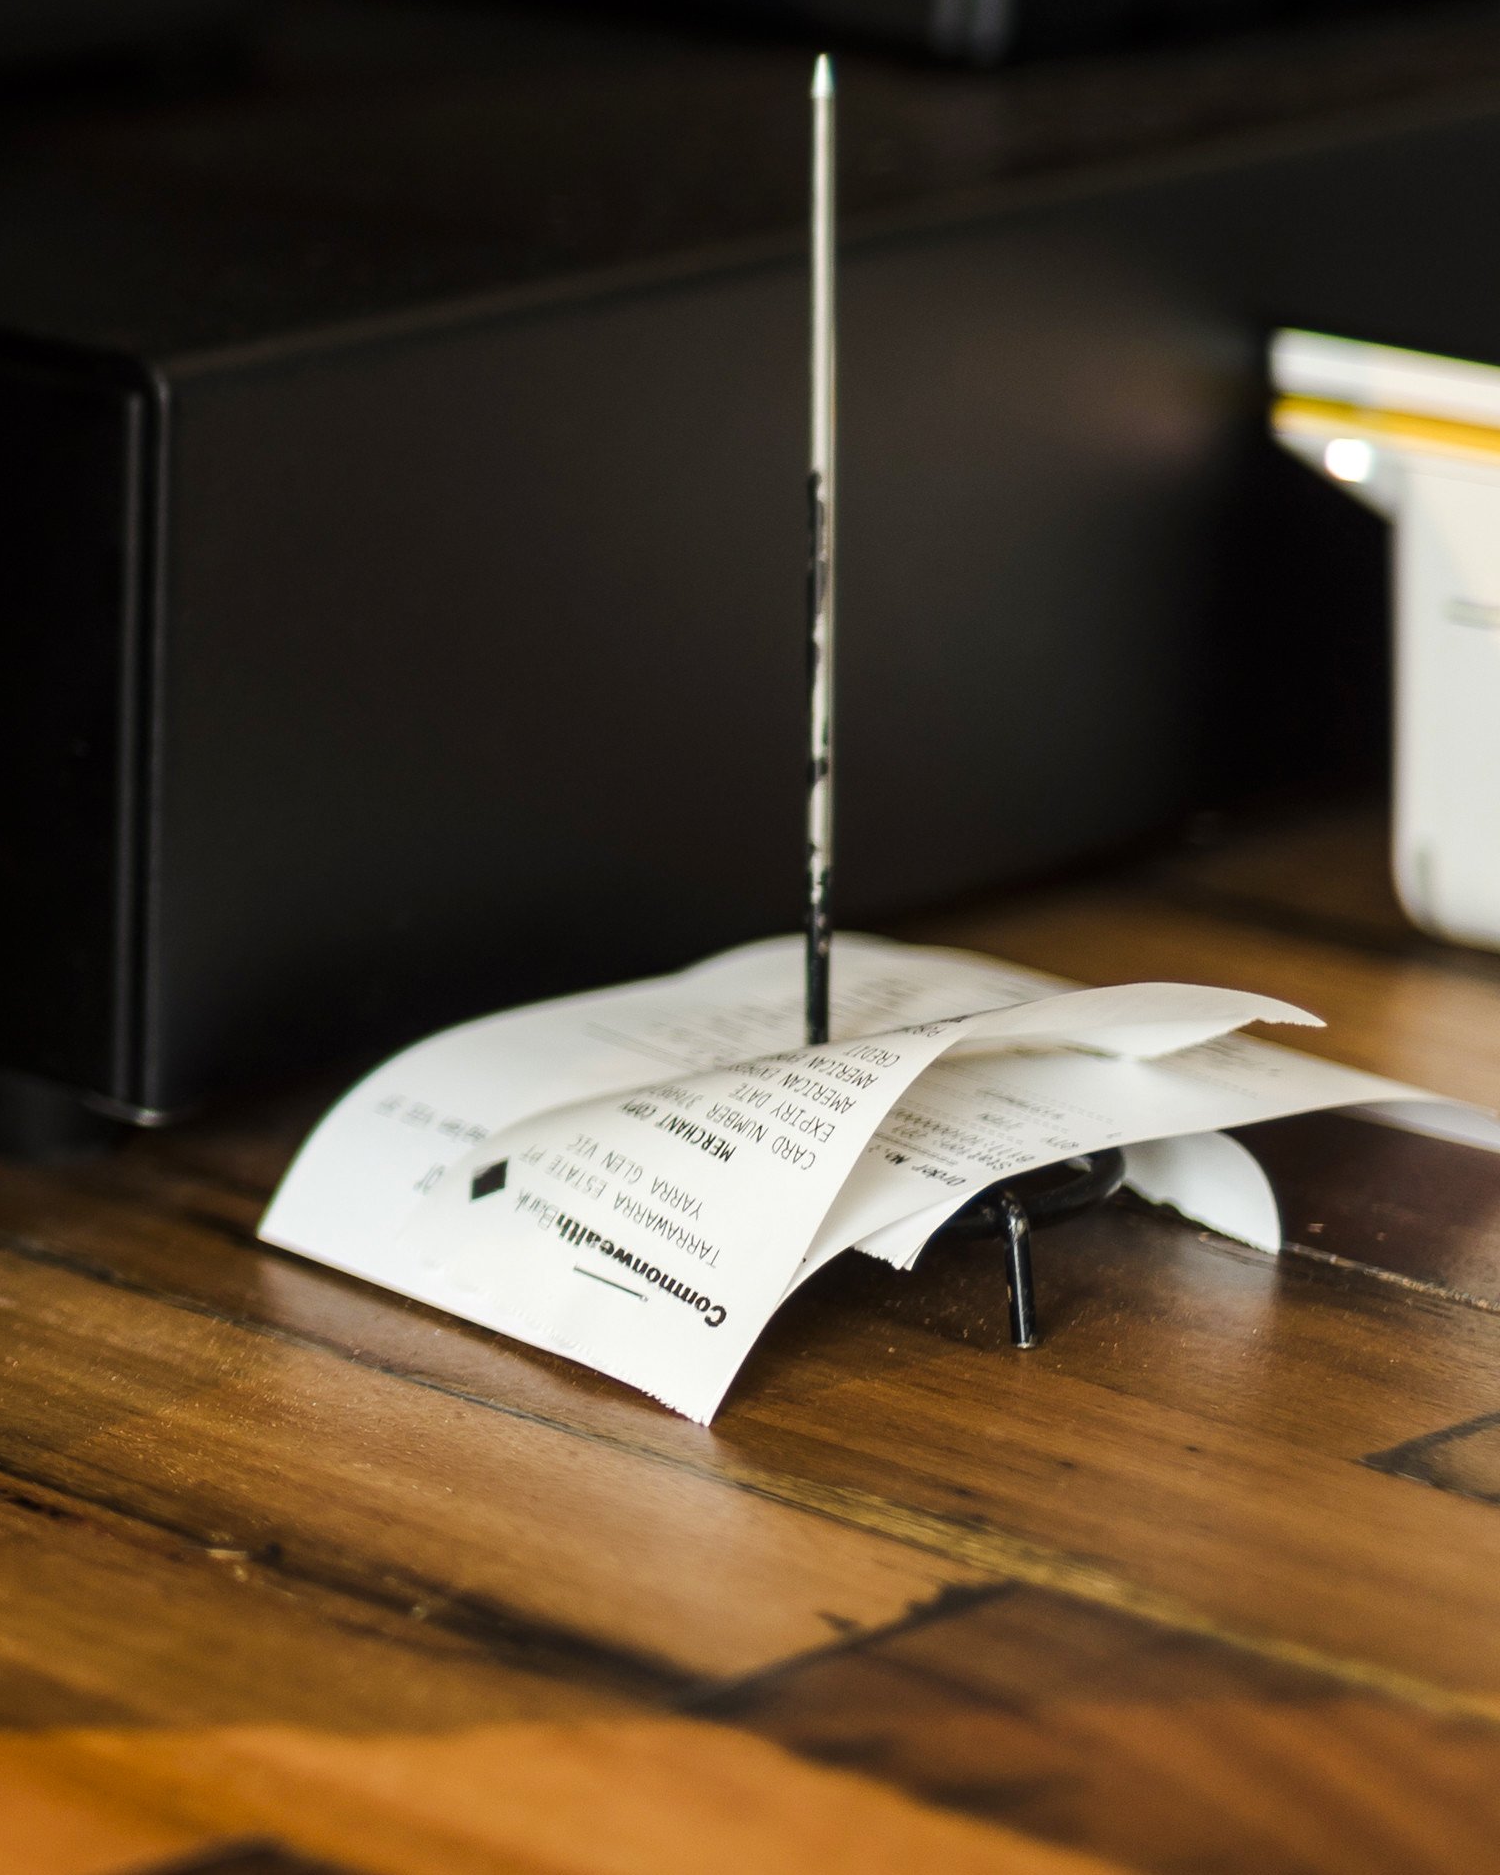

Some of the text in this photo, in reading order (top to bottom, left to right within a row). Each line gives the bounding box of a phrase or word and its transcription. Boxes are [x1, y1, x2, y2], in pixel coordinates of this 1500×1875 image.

[805, 1055, 880, 1091] AMERICAN
[842, 1043, 901, 1069] CREDIT
[728, 1082, 773, 1107] DATE
[778, 1072, 858, 1115] AMERICAN
[655, 1119, 738, 1163] MERCHANT
[705, 1102, 817, 1171] CARD NUMBER
[770, 1103, 836, 1143] EXPIRY
[548, 1154, 607, 1201] ESTATE
[566, 1132, 704, 1221] YARRA GLEN VIC
[613, 1190, 721, 1269] TARRAWARRA
